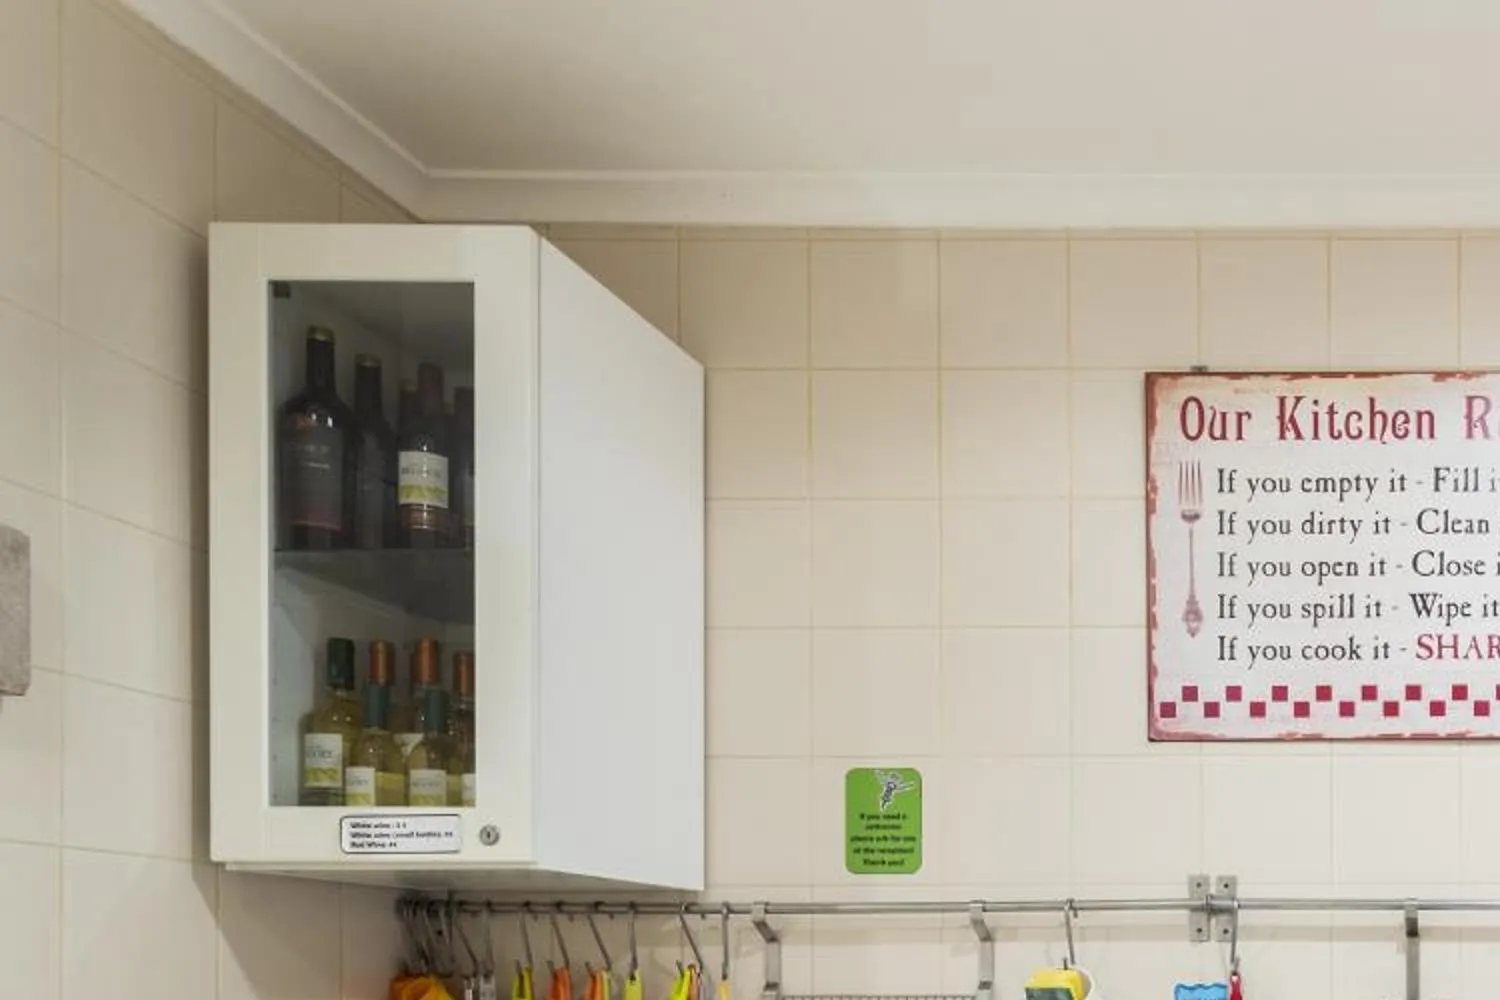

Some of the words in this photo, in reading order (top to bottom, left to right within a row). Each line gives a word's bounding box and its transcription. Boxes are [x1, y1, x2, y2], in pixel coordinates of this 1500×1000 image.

[1180, 396, 1252, 442] Our
[1275, 396, 1436, 446] Kitchen
[1216, 468, 1237, 494] If
[1246, 476, 1292, 502] you
[1300, 474, 1379, 502] empty
[1389, 468, 1407, 493] it
[1433, 467, 1480, 493] Fill
[1216, 509, 1237, 536] If
[1246, 519, 1292, 544] you
[1300, 509, 1364, 544] dirty
[1373, 510, 1392, 536] it
[1415, 507, 1490, 535] Clean
[1216, 551, 1237, 578] If
[1246, 561, 1292, 587] you
[1300, 560, 1360, 587] open
[1368, 551, 1387, 577] it
[1411, 549, 1486, 577] Close
[1217, 593, 1237, 620] If
[1246, 603, 1292, 629] you
[1300, 592, 1355, 629] spill
[1364, 594, 1382, 619] it
[1407, 591, 1472, 628] Wipe
[1482, 593, 1499, 618] it
[1217, 635, 1238, 662] If
[1247, 645, 1292, 670] you
[1300, 635, 1363, 661] cook
[1372, 635, 1391, 661] it
